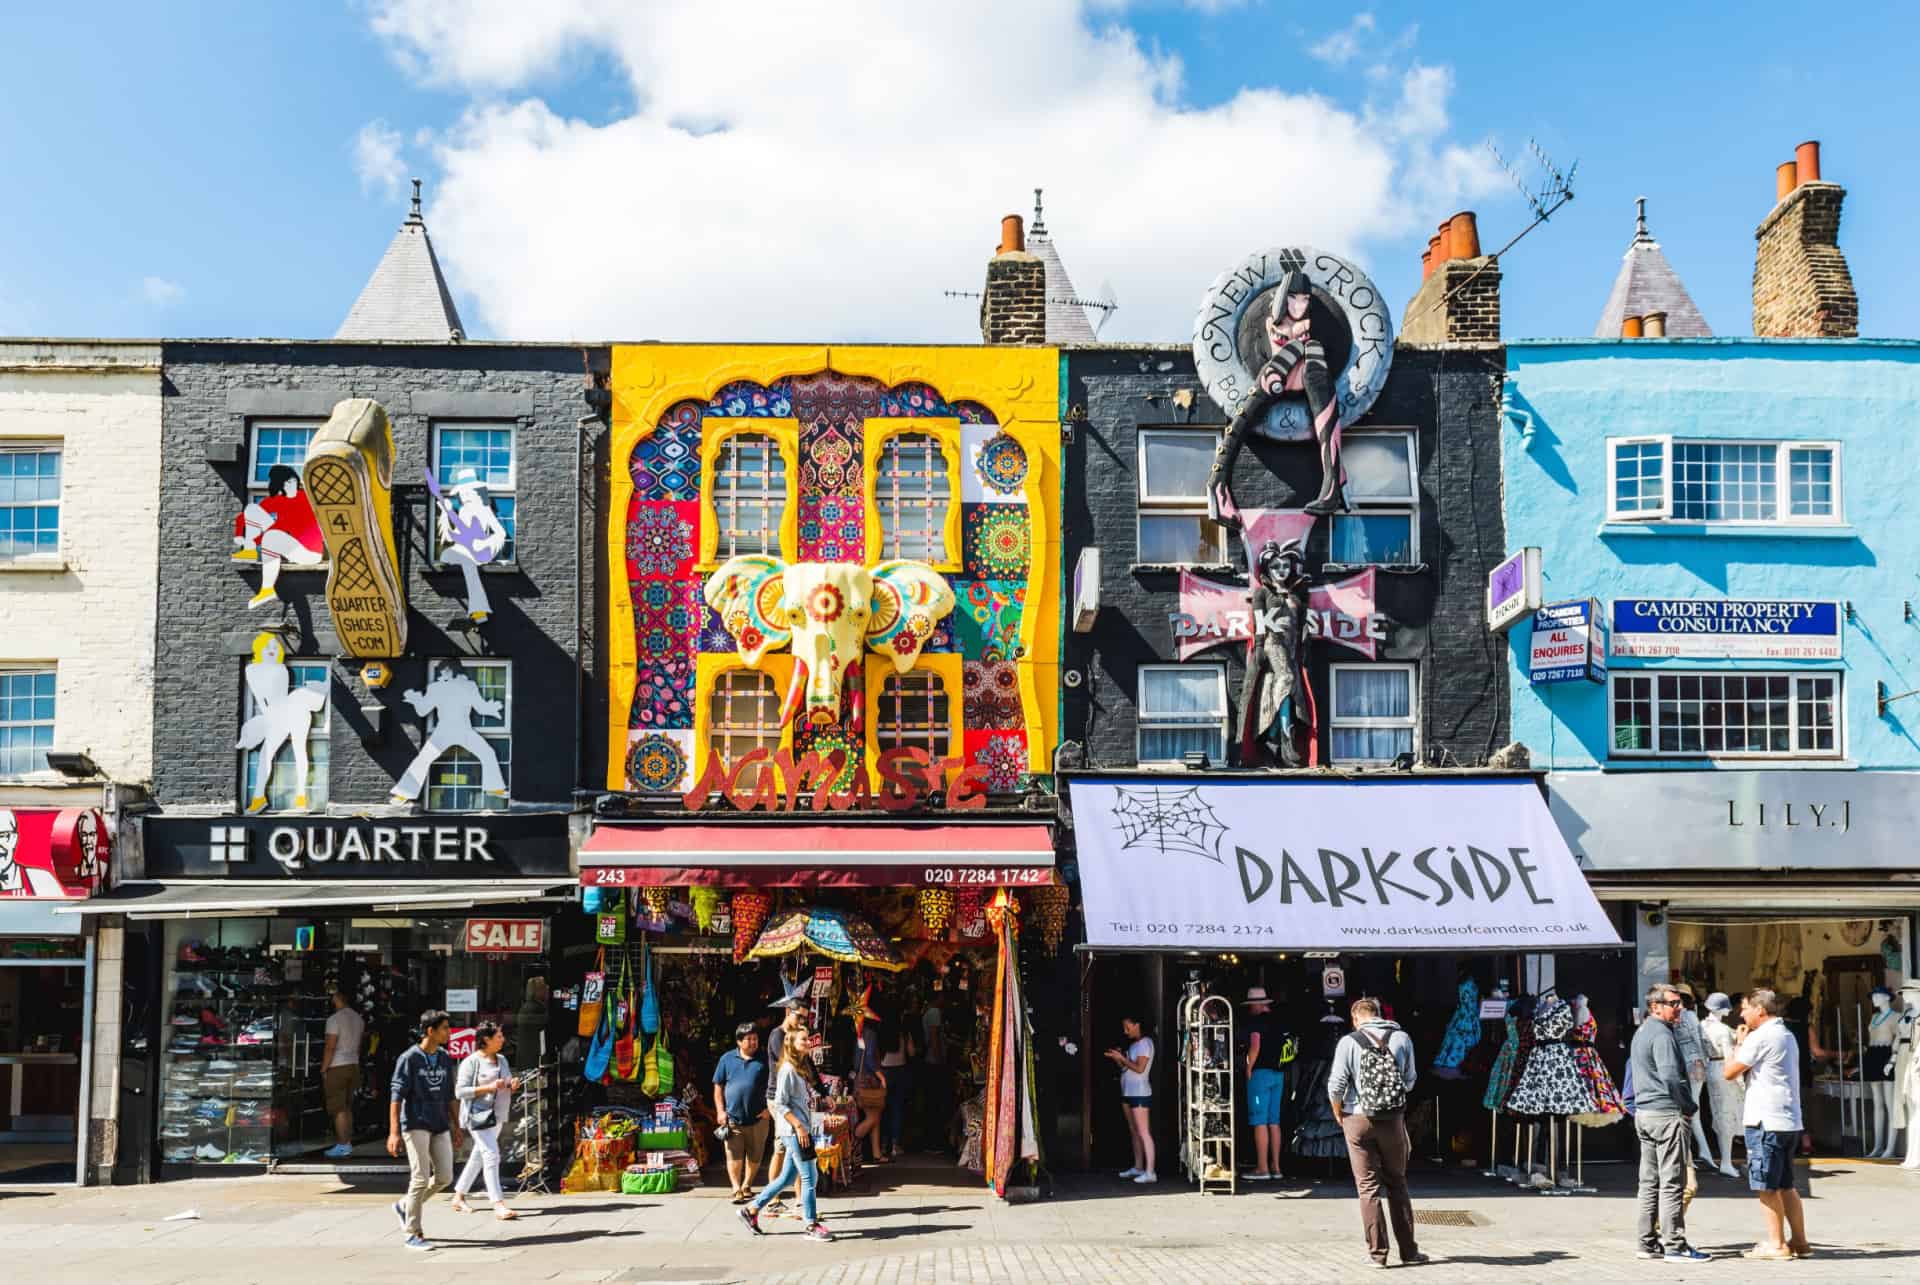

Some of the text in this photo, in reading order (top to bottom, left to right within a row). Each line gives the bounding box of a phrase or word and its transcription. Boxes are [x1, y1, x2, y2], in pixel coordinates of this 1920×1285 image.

[1202, 254, 1386, 370] NEW ROCK
[1280, 407, 1298, 430] &
[332, 513, 348, 532] 4
[331, 598, 387, 613] QUARTER
[1634, 601, 1817, 618] CAMDEN PROPERTY
[343, 617, 385, 632] SHOES
[1657, 617, 1793, 633] CONSULTANCY
[1550, 632, 1568, 643] ALL
[1533, 644, 1584, 659] ENQUIRIES
[268, 825, 494, 869] QUARTER
[596, 869, 625, 884] 243
[925, 868, 1040, 882] 020 7284 1742
[469, 923, 540, 948] SALE
[1110, 921, 1275, 935] Tel: 020 7284 2174
[1340, 922, 1591, 936] www.darksideofcamden.co.uk
[450, 1040, 477, 1055] SAL
